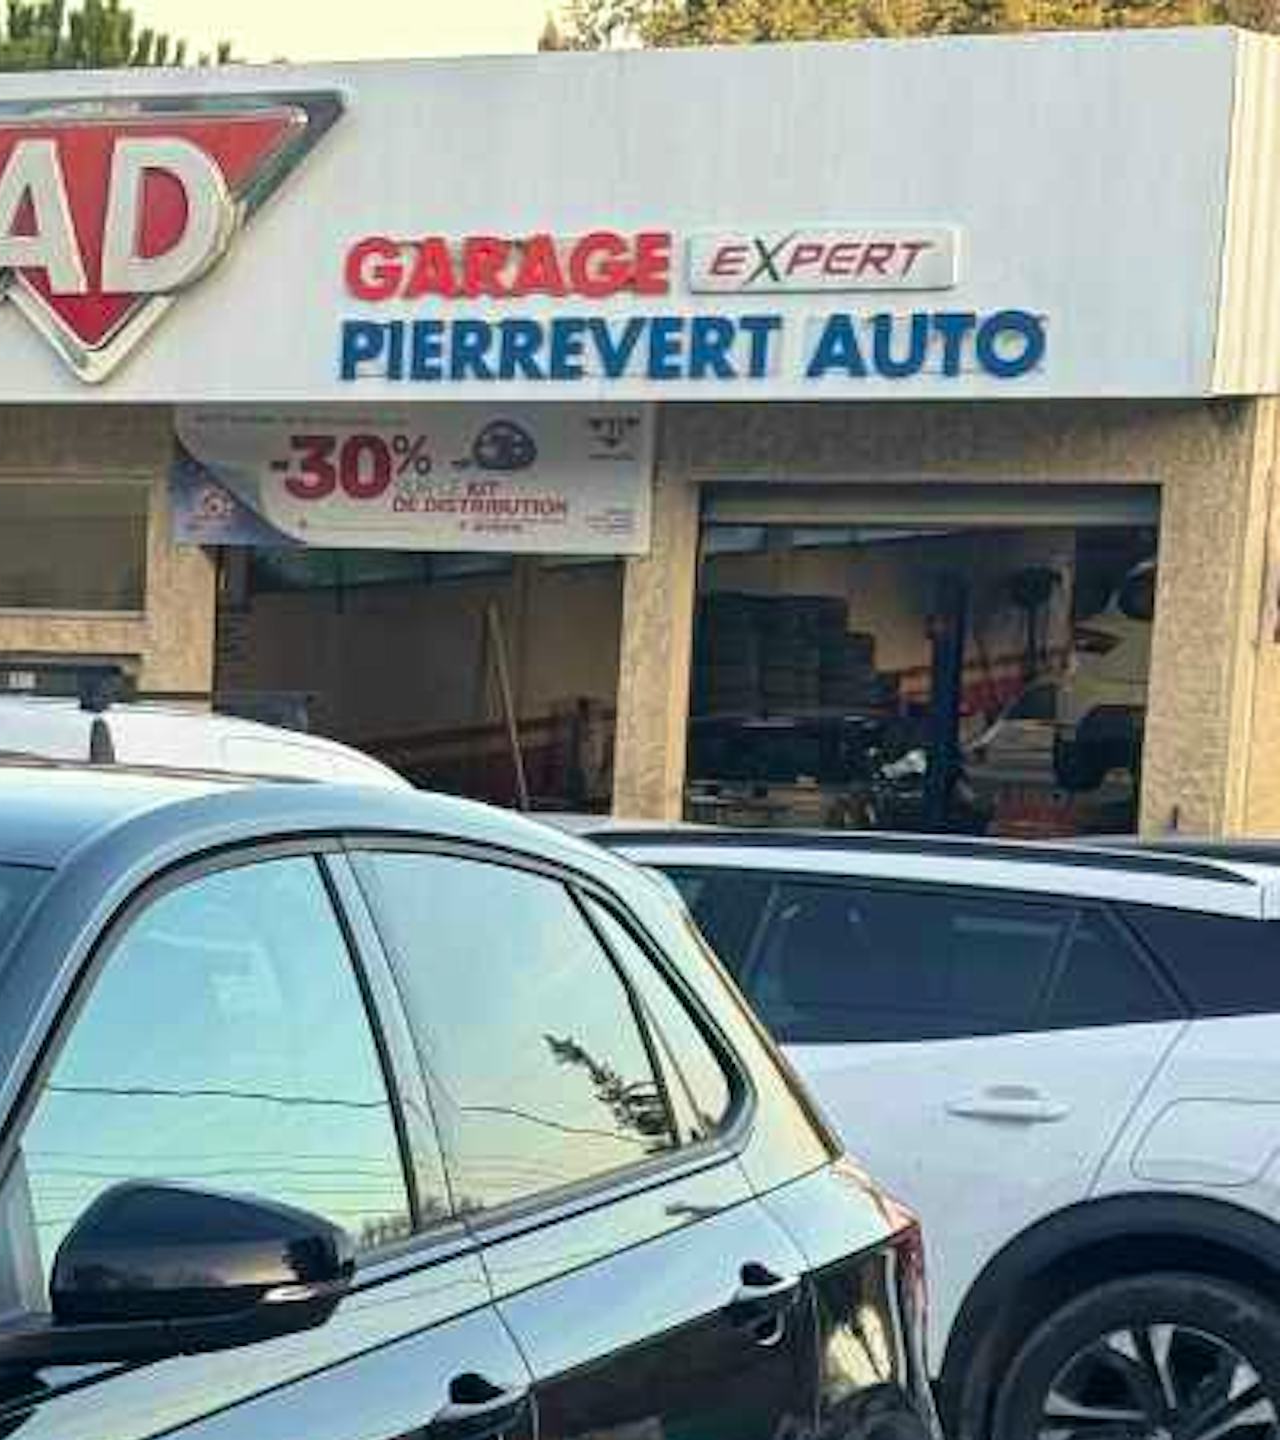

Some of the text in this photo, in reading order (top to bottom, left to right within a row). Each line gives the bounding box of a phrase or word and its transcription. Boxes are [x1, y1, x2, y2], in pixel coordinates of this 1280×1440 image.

[344, 232, 936, 301] GARAGE EXPERT
[339, 310, 1047, 382] PIERREVERT AUTO
[269, 434, 432, 501] -30%
[423, 497, 567, 516] DISTRIBUTION
